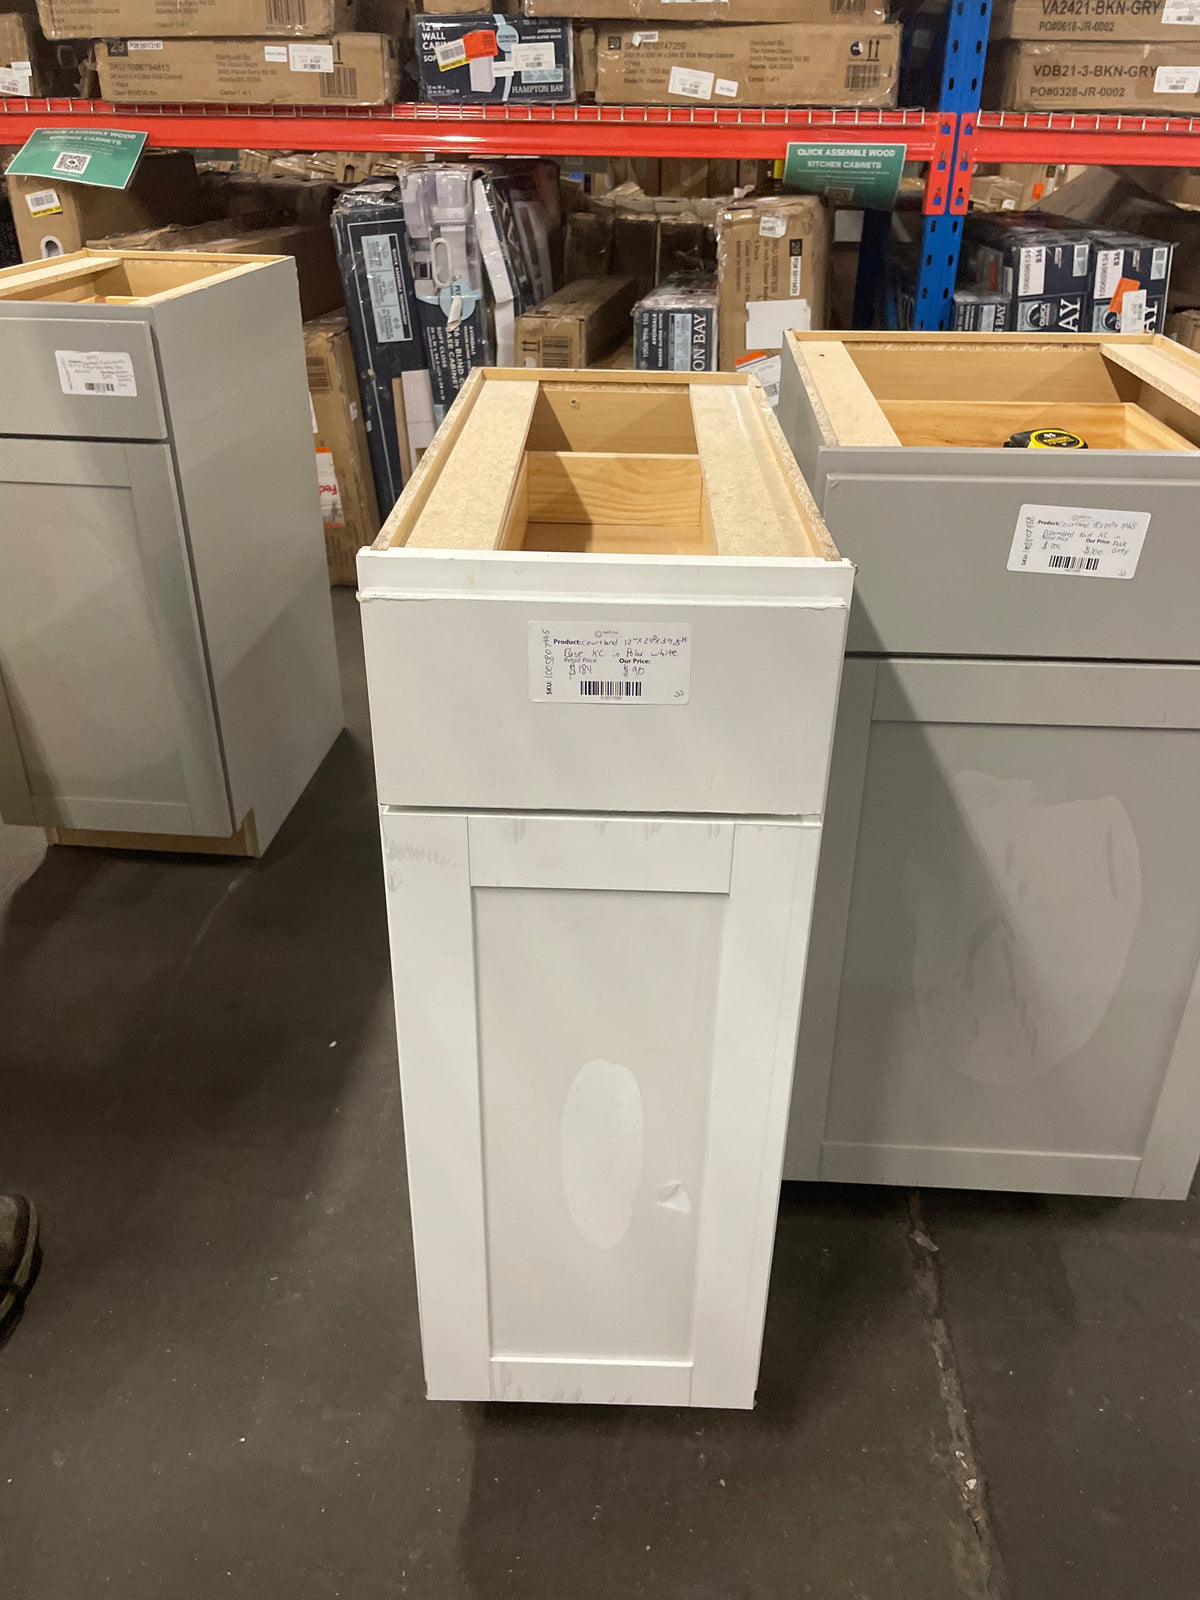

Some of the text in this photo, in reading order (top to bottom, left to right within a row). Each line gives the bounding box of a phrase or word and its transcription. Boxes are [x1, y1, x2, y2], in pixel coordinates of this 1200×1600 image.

[422, 32, 446, 40] WALL
[1033, 65, 1158, 78] VDB21-3-BKN-GRY
[512, 84, 564, 94] HAMPTON BAY
[797, 148, 896, 157] QUICK ASSEMBLE WOOD
[807, 160, 882, 169] KITCHEN CABINETS
[996, 304, 1006, 325] BAY
[693, 314, 706, 344] BAY
[439, 346, 447, 368] CLOSE
[456, 348, 464, 375] BLIND
[448, 352, 458, 390] CABINET
[553, 638, 580, 646] Product:
[592, 649, 604, 657] KC
[612, 650, 620, 658] in
